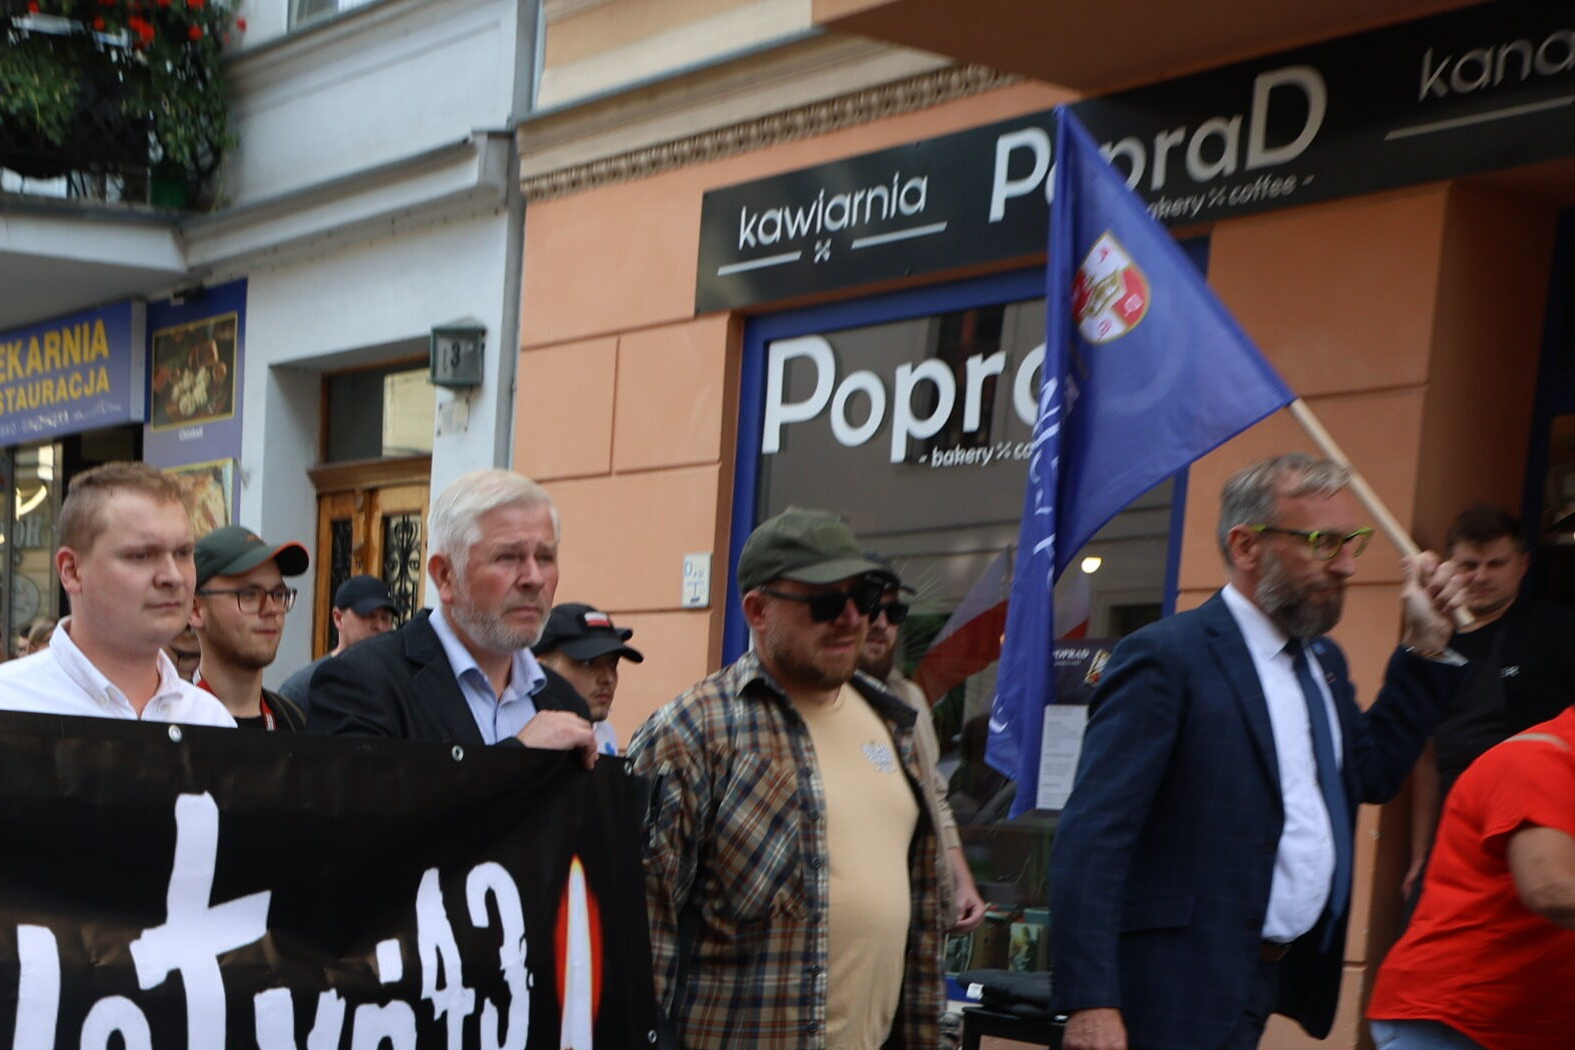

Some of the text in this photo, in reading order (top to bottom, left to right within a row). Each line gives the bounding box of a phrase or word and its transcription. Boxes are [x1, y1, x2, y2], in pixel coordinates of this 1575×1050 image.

[1228, 172, 1297, 206] coffee
[738, 171, 928, 251] kawiarnia
[931, 444, 994, 467] bakery
